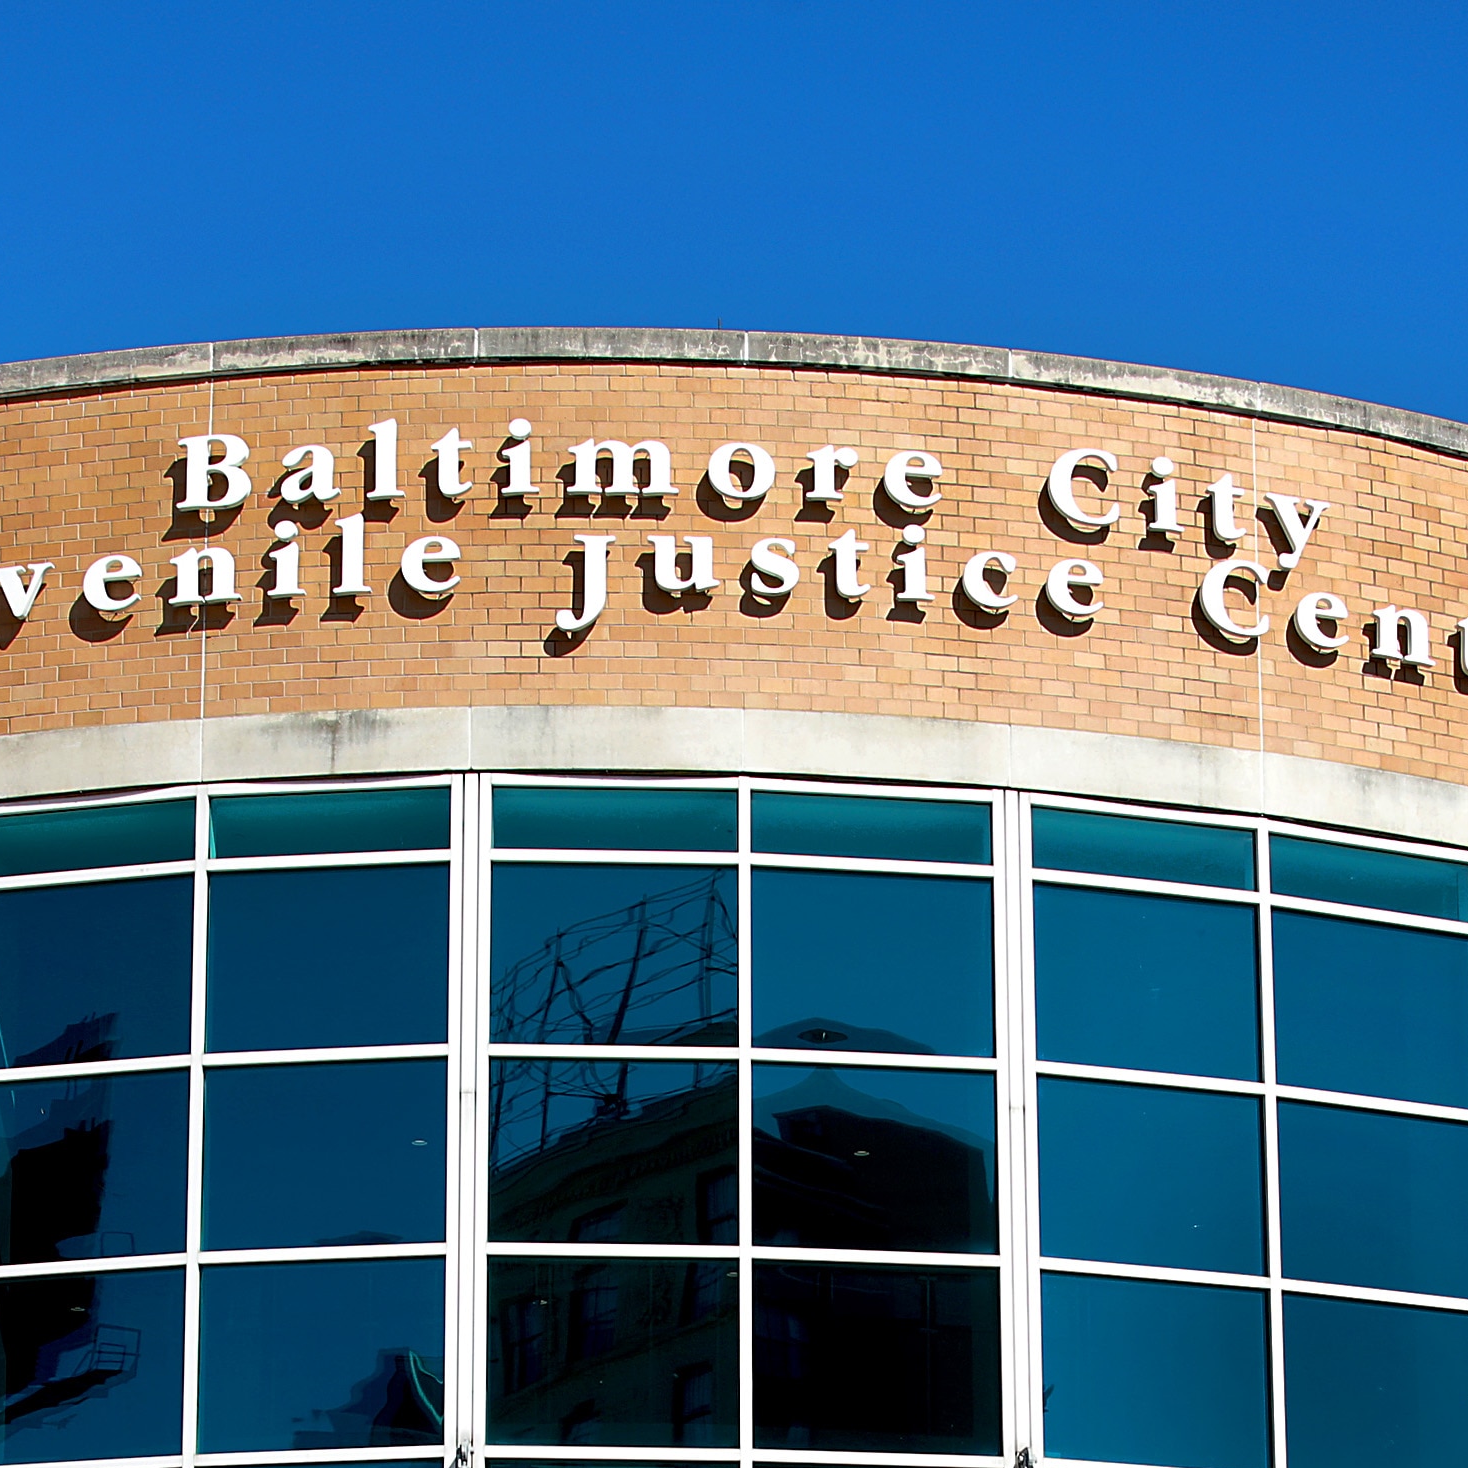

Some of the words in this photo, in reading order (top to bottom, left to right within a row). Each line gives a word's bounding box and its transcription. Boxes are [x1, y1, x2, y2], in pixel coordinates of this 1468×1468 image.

[174, 417, 944, 509] Baltimore
[1047, 446, 1332, 569] City
[555, 524, 1105, 632] Justice
